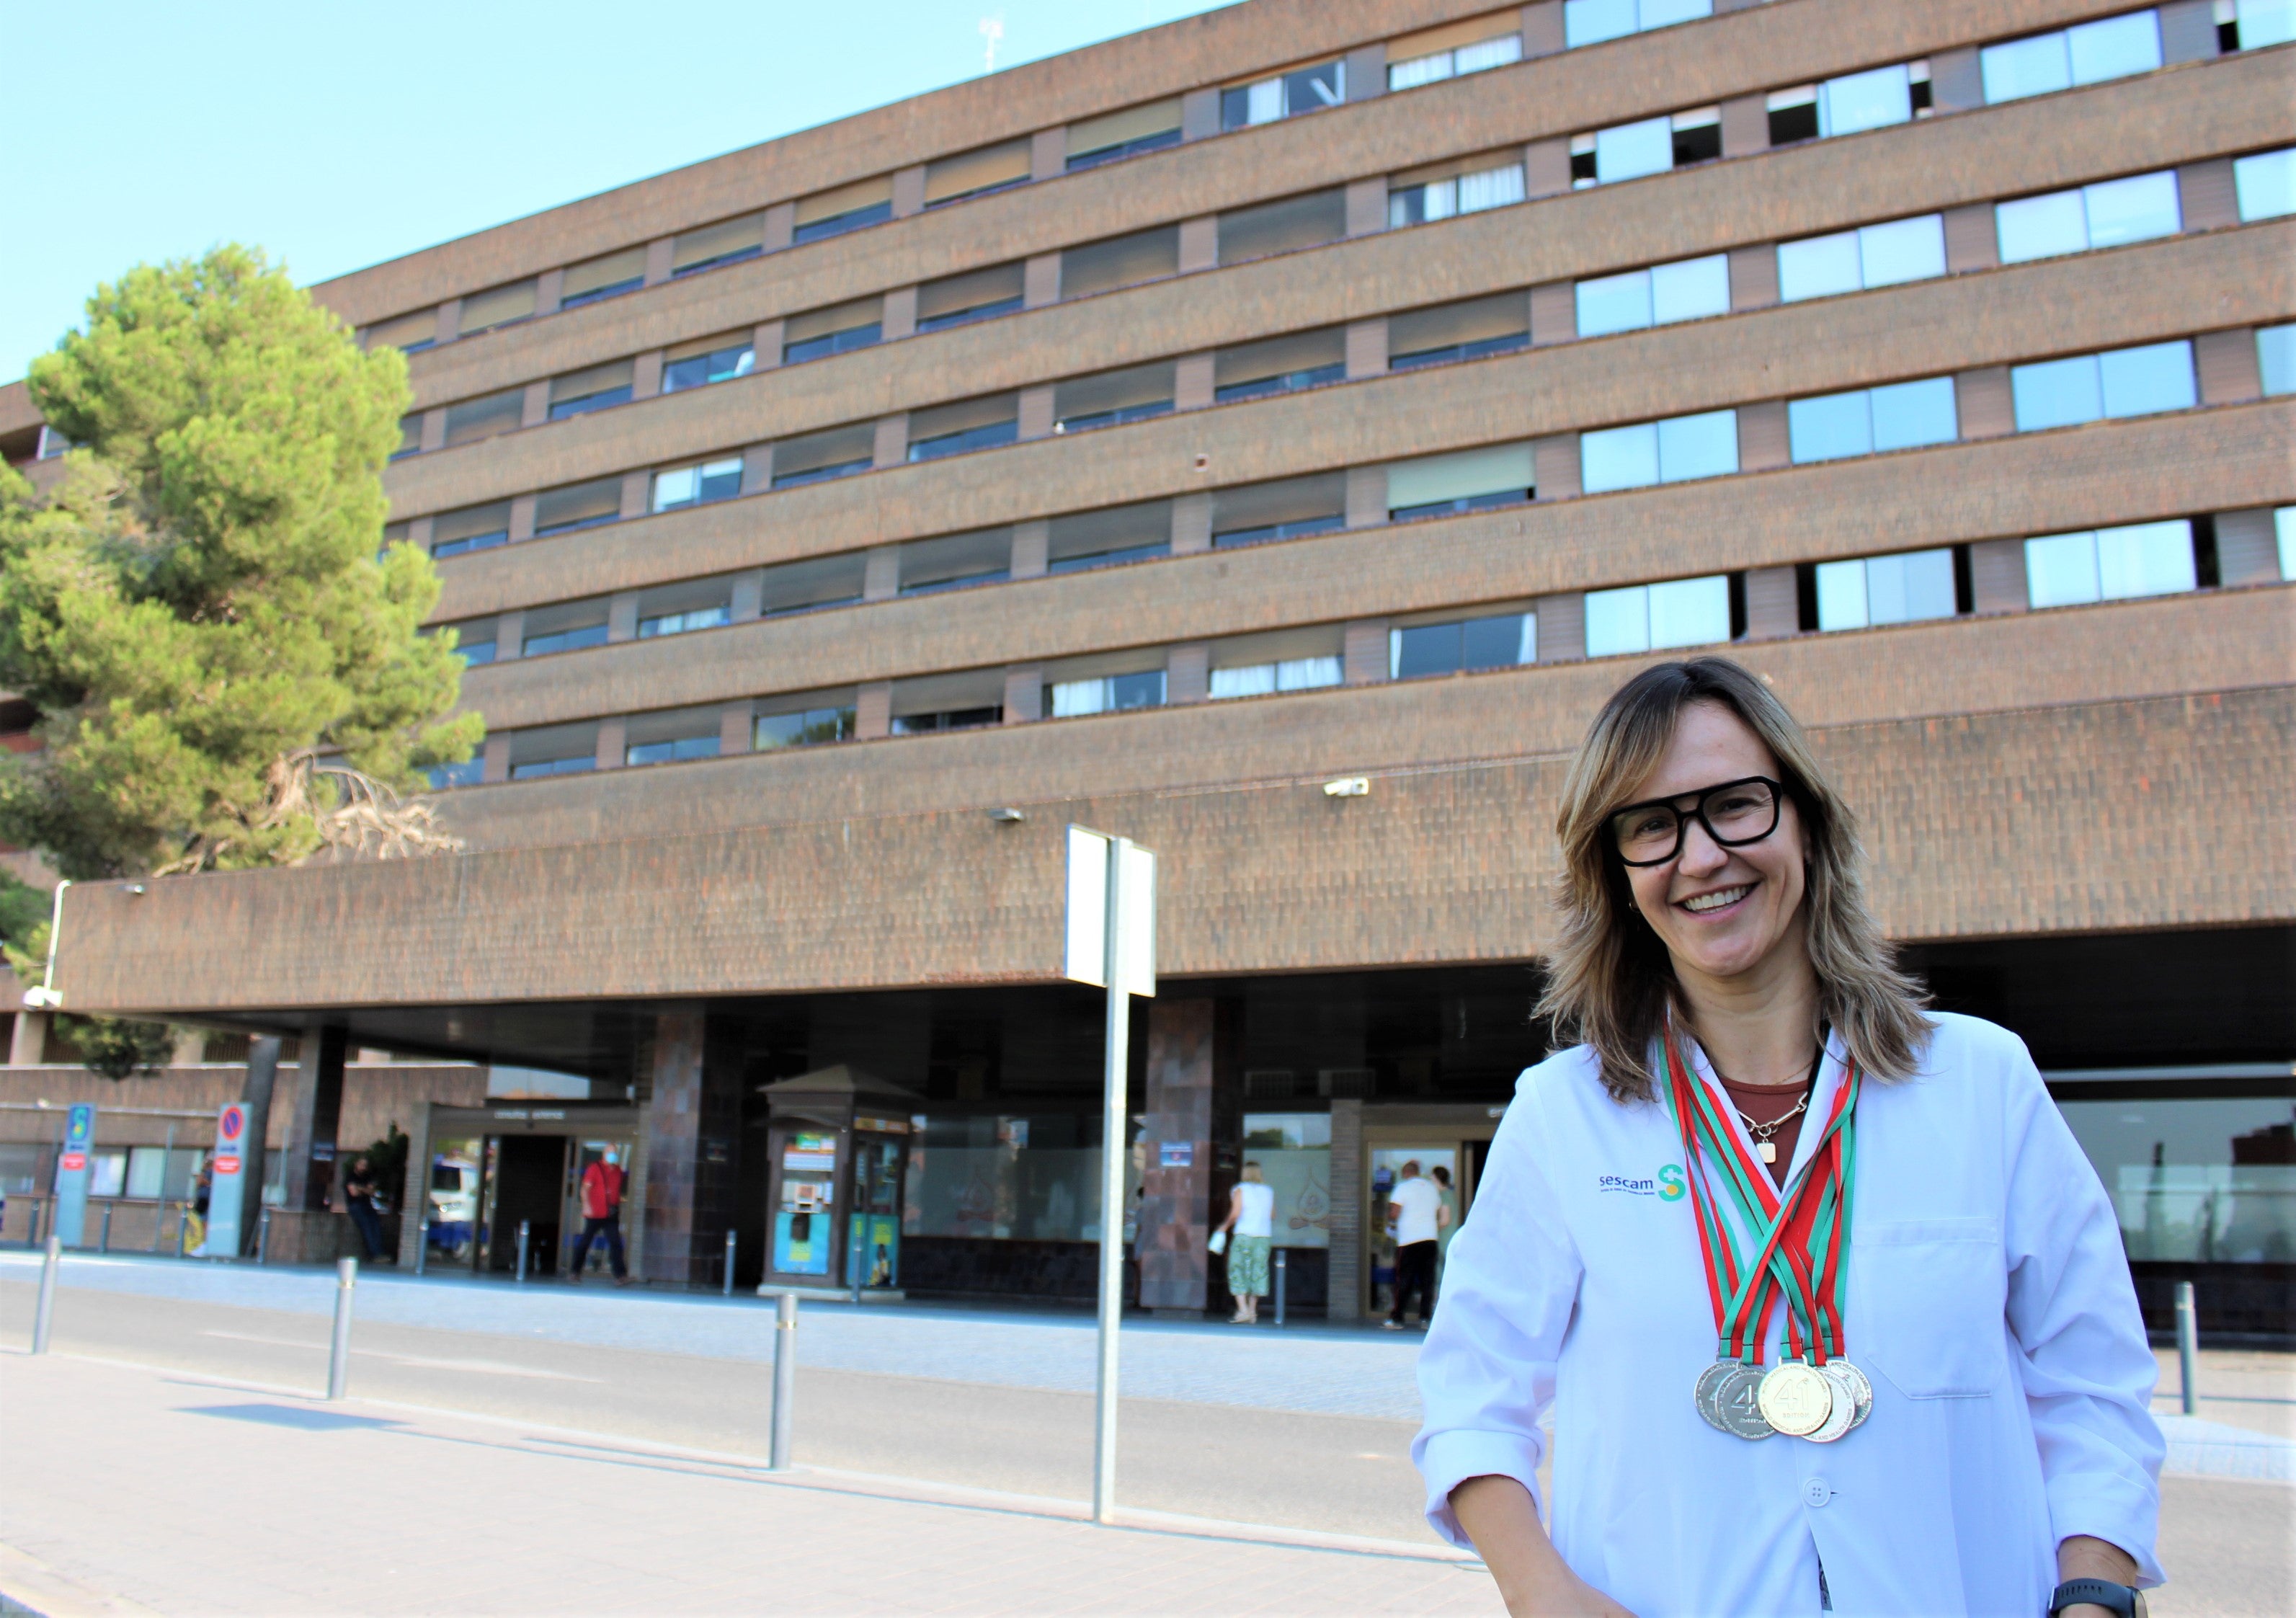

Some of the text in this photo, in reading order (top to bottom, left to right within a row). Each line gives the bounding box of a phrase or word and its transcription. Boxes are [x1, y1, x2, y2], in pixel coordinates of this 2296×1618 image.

[1600, 1175, 1653, 1189] sescam
[1771, 1366, 1789, 1378] MEDICAL
[1801, 1366, 1819, 1379] HEALTH
[1842, 1362, 1860, 1376] HEALTH
[1824, 1372, 1842, 1384] HEALTH
[1773, 1419, 1793, 1433] MEDICAL
[1805, 1420, 1820, 1431] HEALTH
[1819, 1402, 1829, 1420] GAMES
[1829, 1425, 1845, 1439] HEALTH
